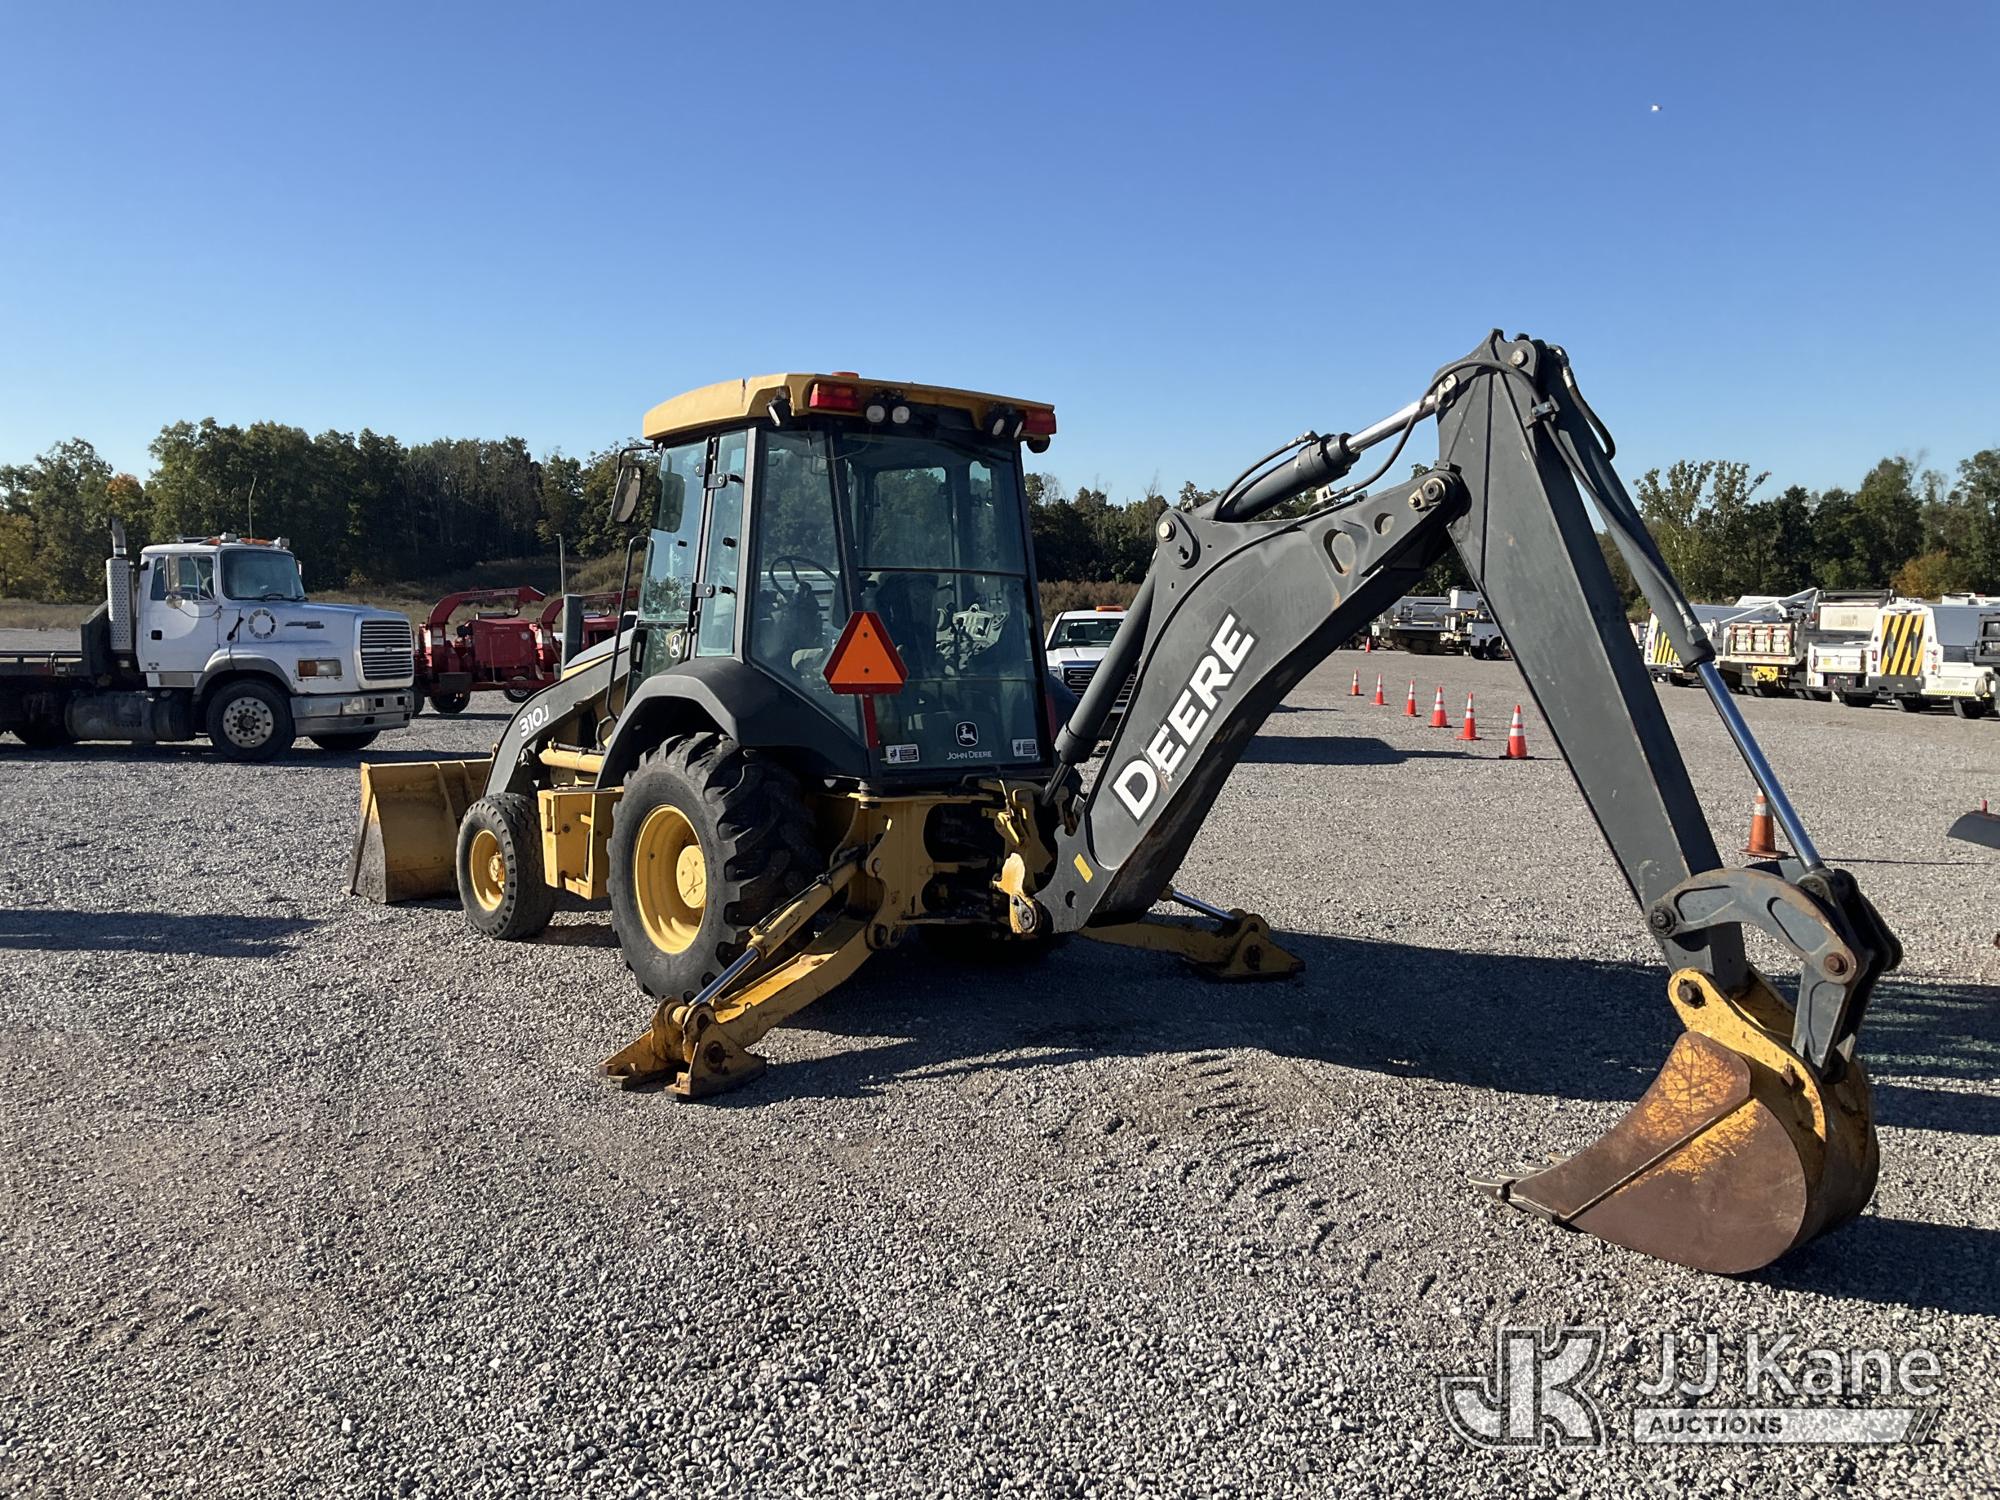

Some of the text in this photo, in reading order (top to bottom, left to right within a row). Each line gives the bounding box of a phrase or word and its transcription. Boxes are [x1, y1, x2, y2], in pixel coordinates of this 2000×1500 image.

[519, 704, 550, 737] 310J
[1113, 613, 1255, 820] DEERE
[947, 750, 992, 760] JOHN DEERE
